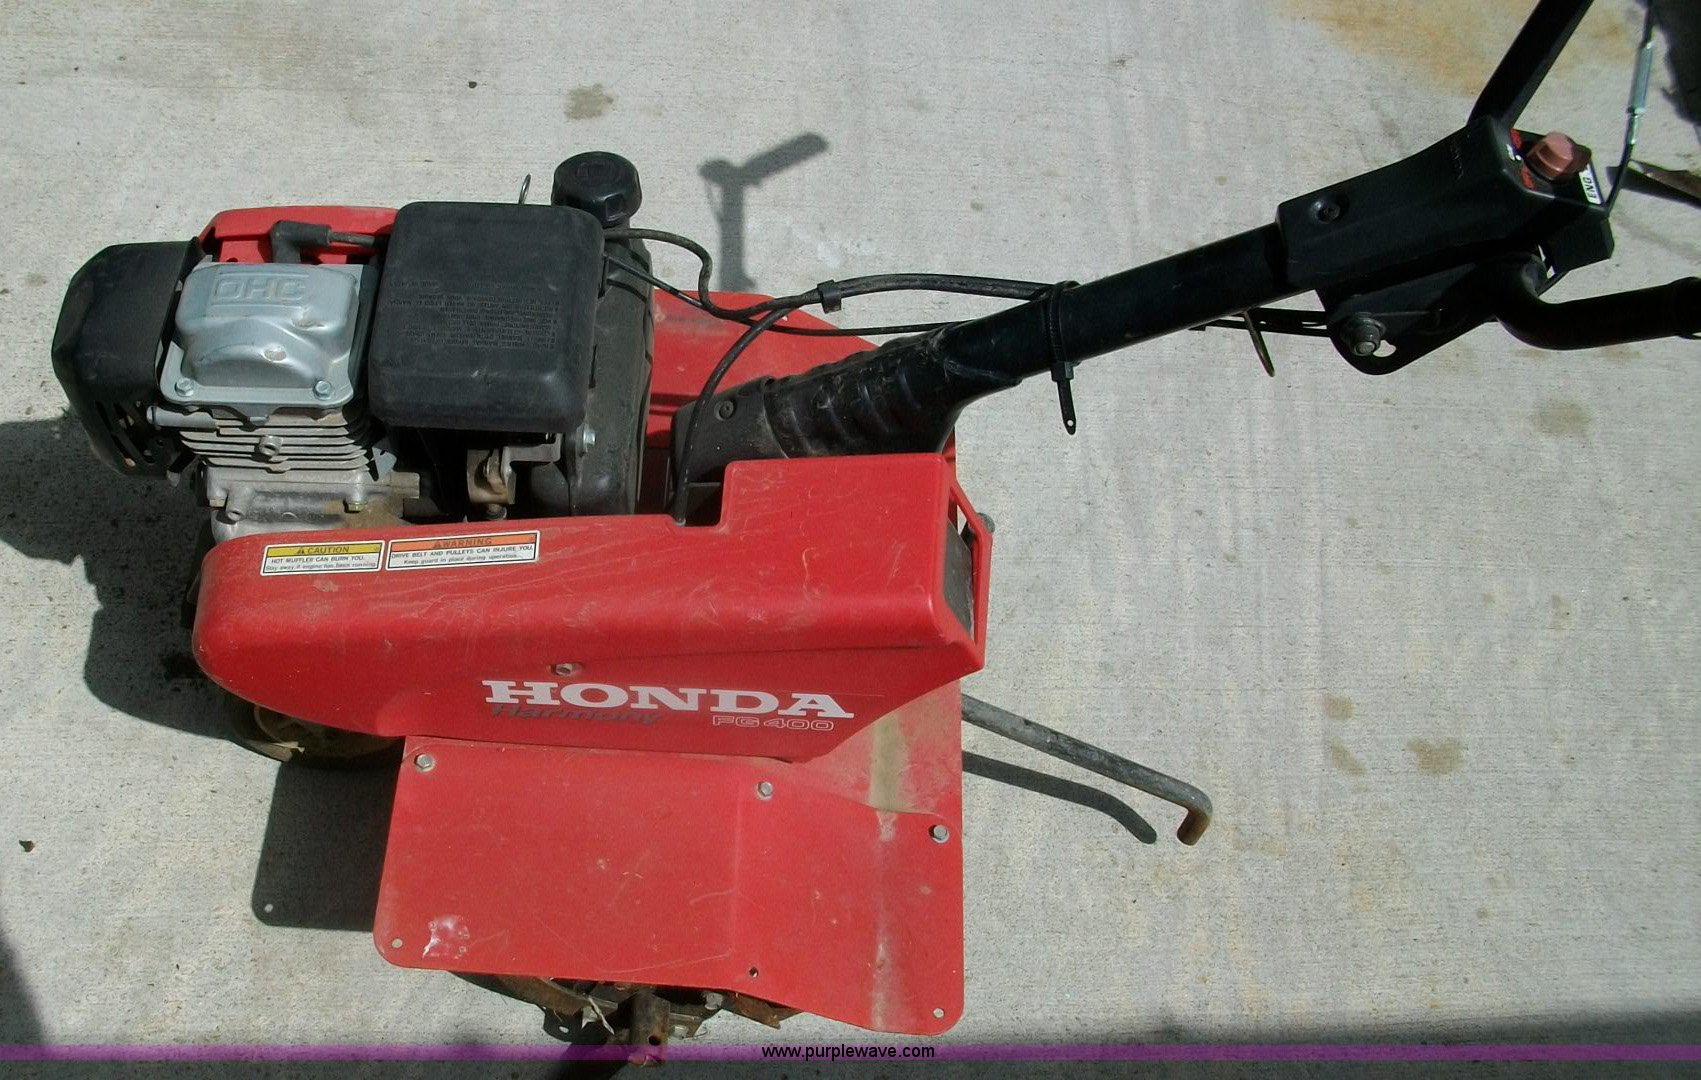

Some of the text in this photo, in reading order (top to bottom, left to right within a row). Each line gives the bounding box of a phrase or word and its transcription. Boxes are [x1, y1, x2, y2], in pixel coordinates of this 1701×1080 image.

[1582, 176, 1597, 198] ENG
[214, 278, 308, 300] OHC
[307, 546, 350, 554] CAUTION
[440, 538, 492, 548] WARNING
[482, 680, 854, 718] HONDA
[489, 703, 664, 726] Harmony
